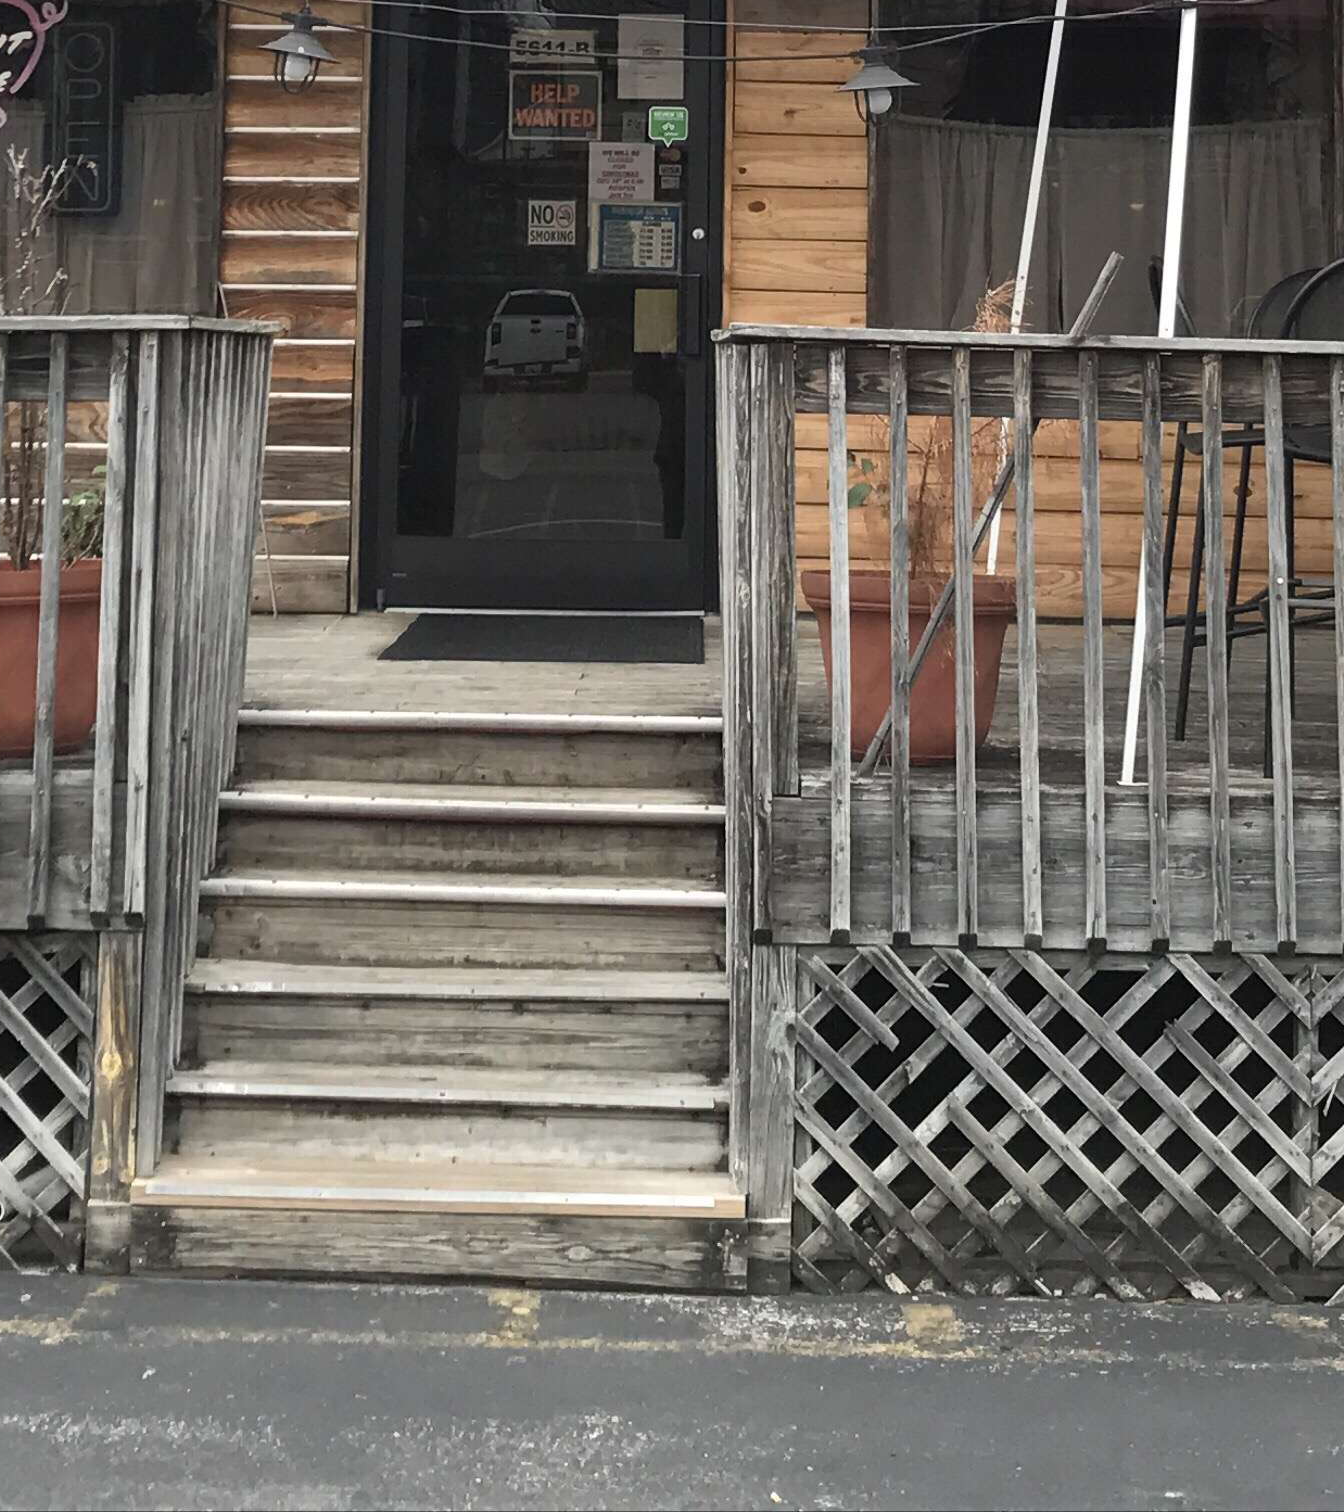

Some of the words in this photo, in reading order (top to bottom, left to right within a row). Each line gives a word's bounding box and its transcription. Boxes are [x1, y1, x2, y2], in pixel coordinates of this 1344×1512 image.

[530, 83, 580, 104] HELP
[64, 32, 105, 201] OPEN
[514, 108, 596, 128] WANTED
[531, 204, 555, 225] NO
[529, 229, 574, 243] SMOKING
